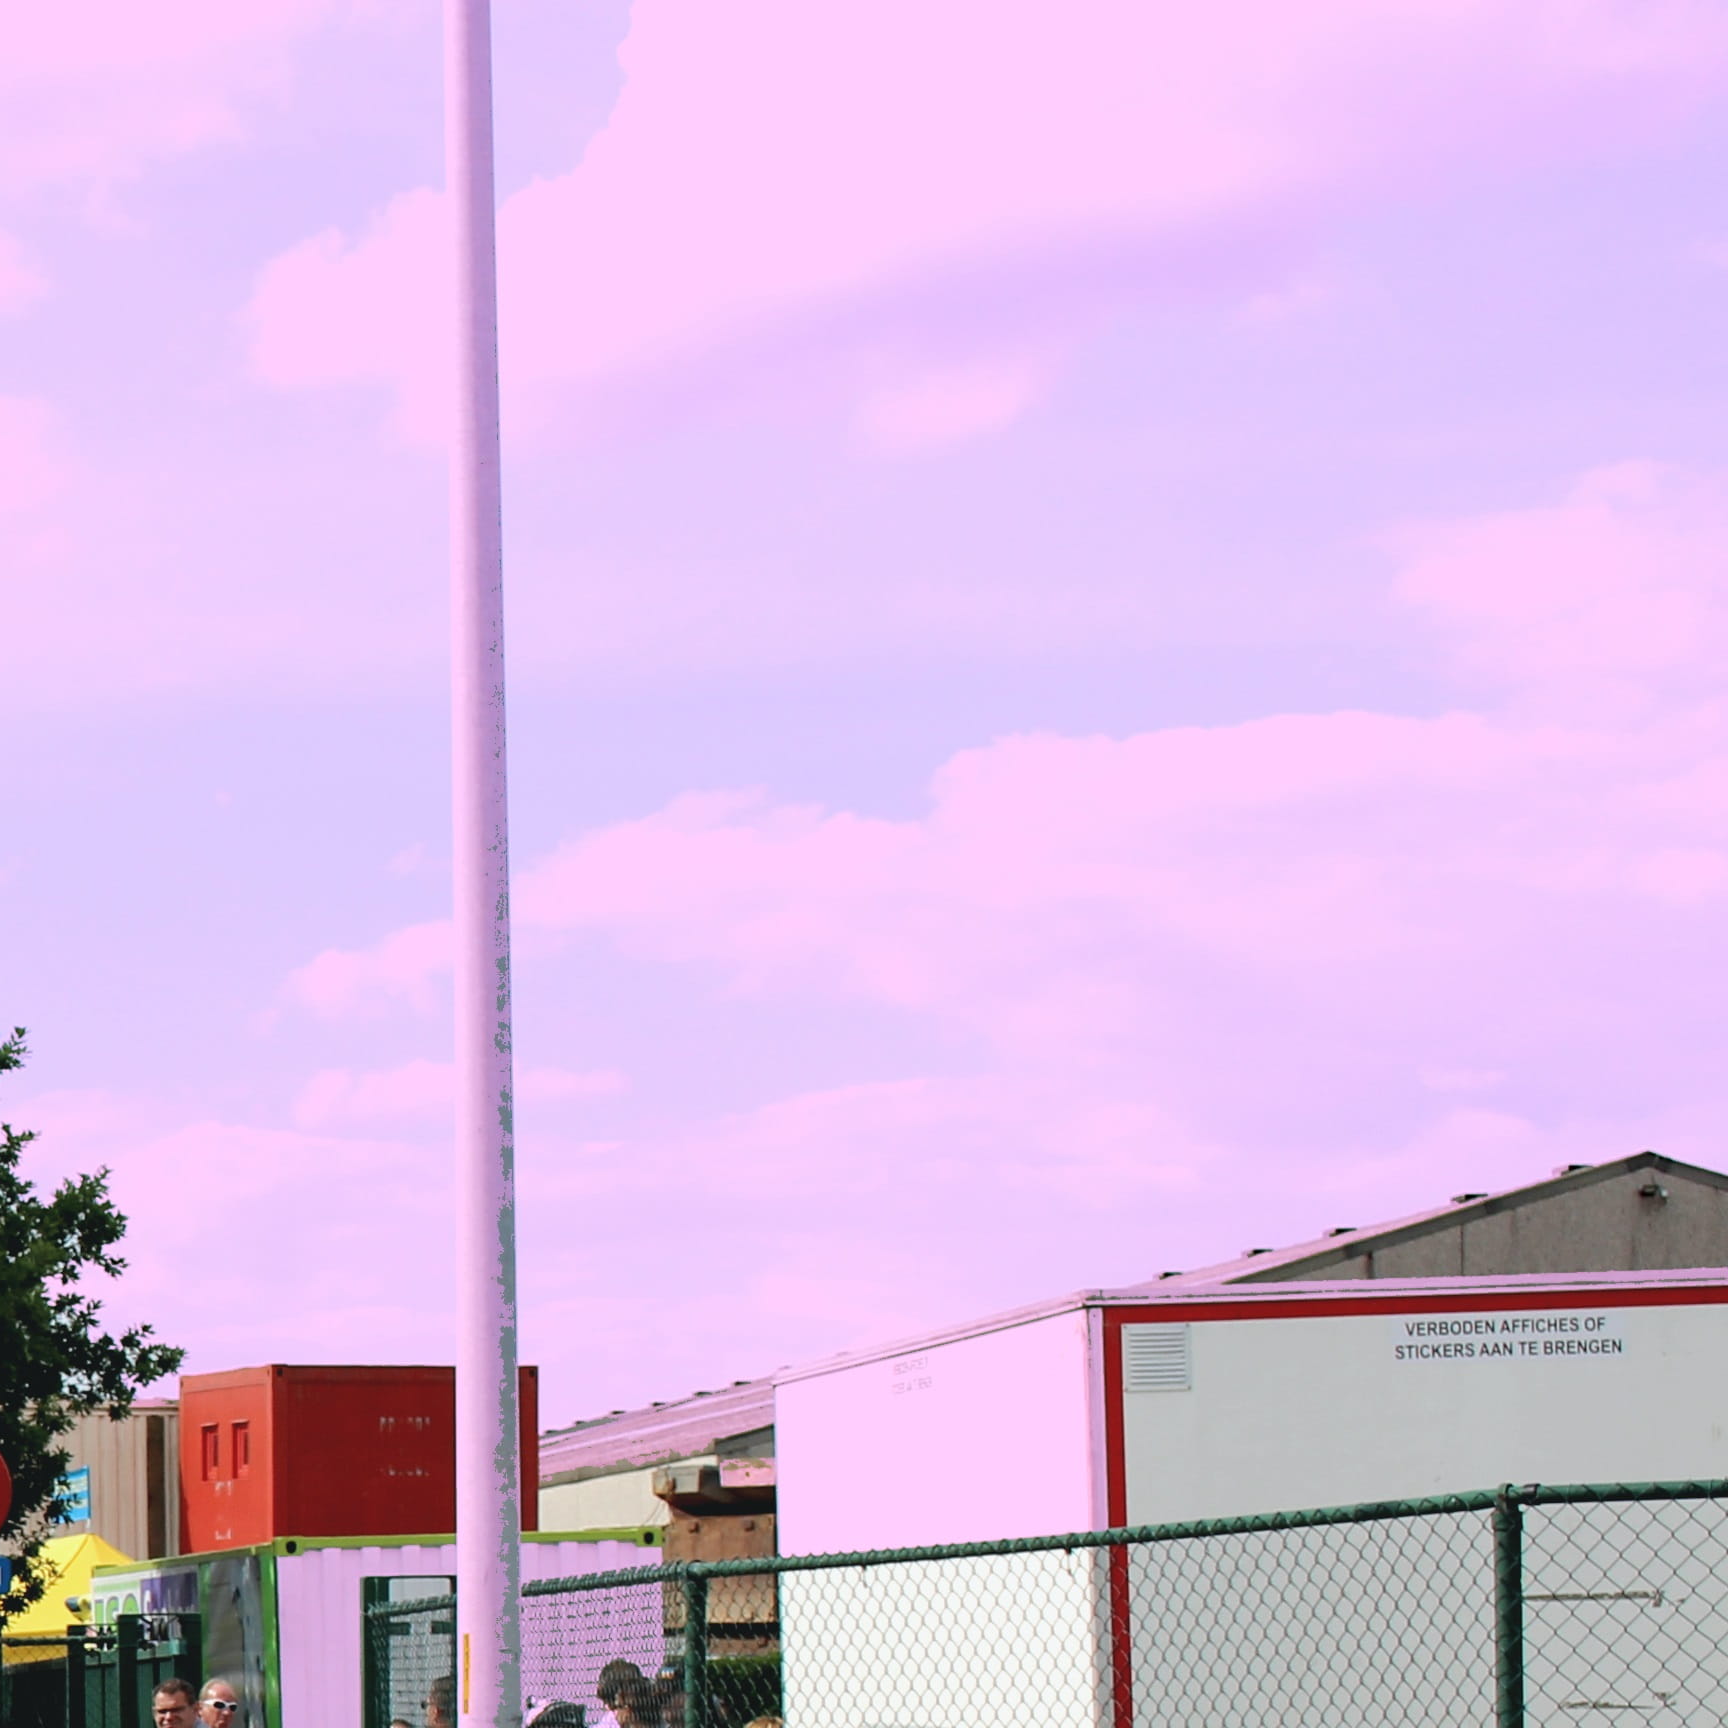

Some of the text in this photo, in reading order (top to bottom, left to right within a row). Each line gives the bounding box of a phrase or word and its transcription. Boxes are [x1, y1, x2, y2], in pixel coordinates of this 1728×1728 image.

[1405, 1316, 1606, 1337] VERBODEN AFFICHES OF
[1395, 1338, 1623, 1360] STICKERS AAN TE BRENGEN
